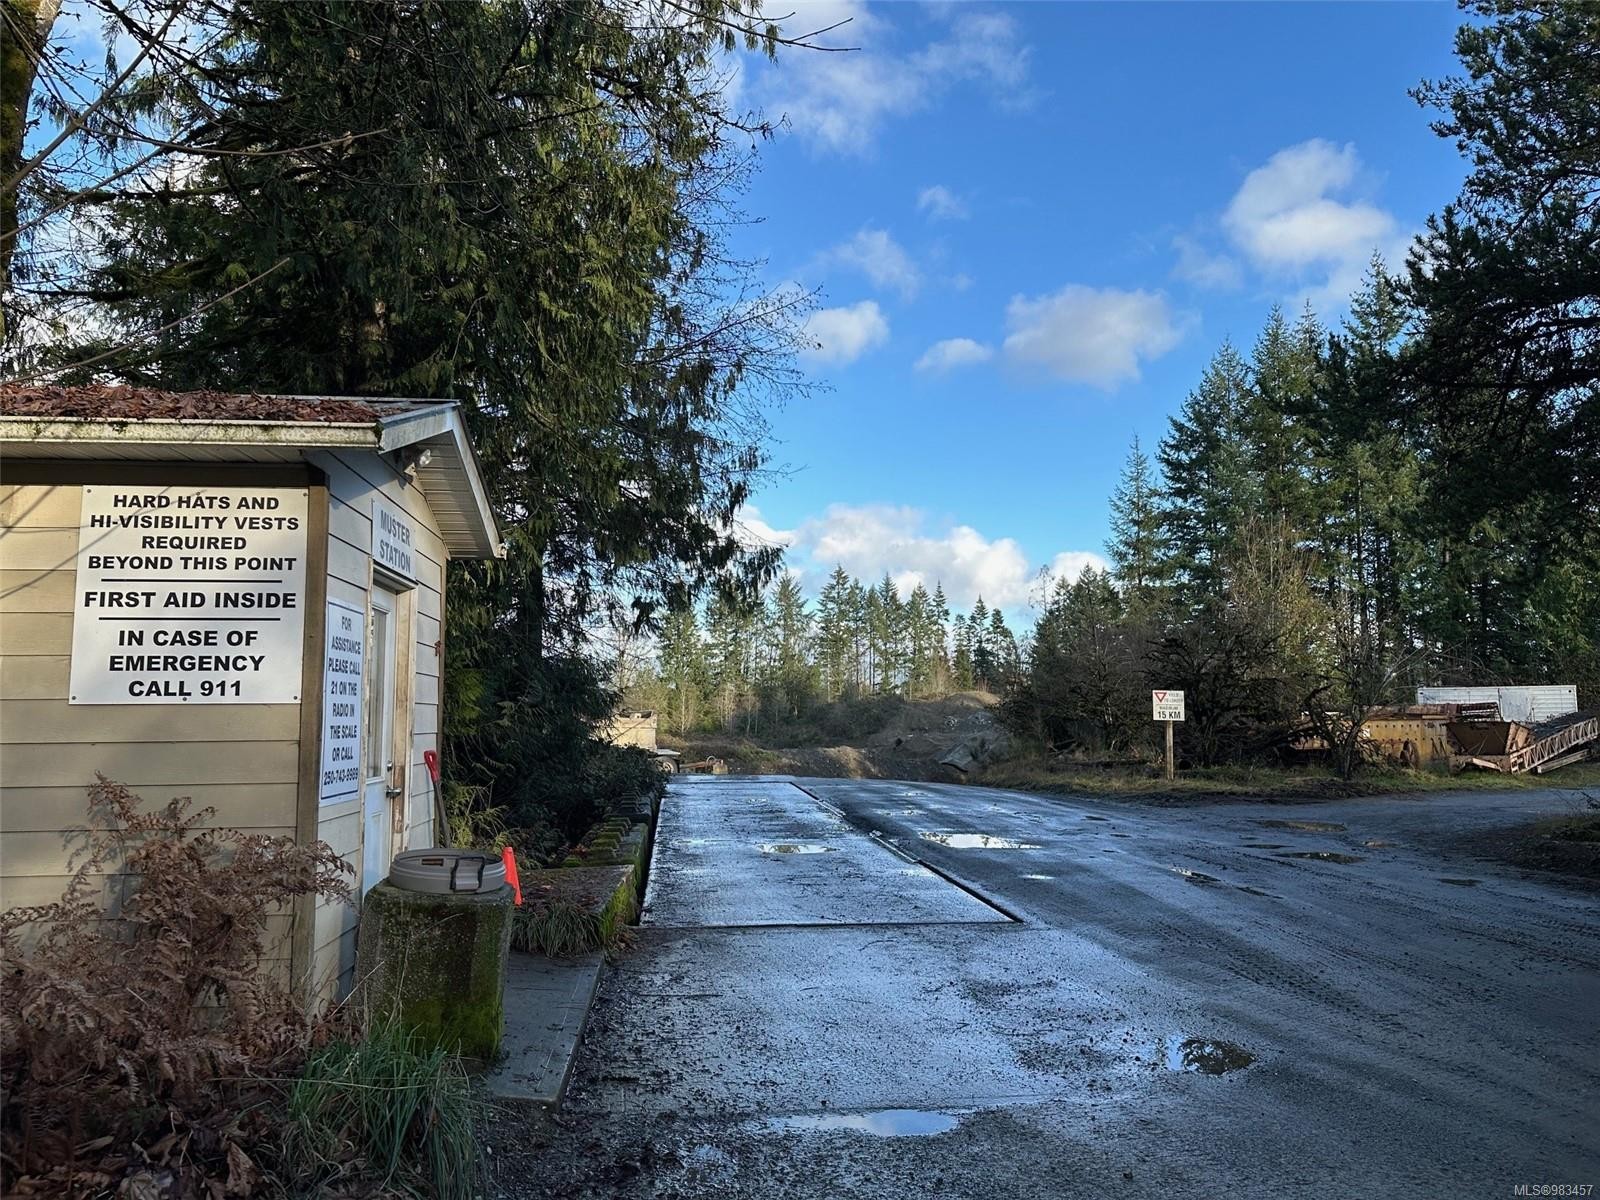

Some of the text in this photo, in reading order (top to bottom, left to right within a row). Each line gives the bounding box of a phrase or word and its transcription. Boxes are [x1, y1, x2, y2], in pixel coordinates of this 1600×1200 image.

[113, 494, 279, 510] HARD HATS AND
[90, 514, 299, 530] HI-VISIBILITY VESTS
[381, 510, 410, 547] MUSTER
[142, 536, 247, 550] REQUIRED
[88, 556, 297, 571] BEYOND THIS POINT
[380, 539, 410, 574] STATION
[84, 592, 297, 608] FIRST AID INSIDE
[341, 616, 352, 631] FOR
[118, 630, 258, 646] IN CASE OF
[331, 636, 361, 655] ASSISTANCE
[109, 656, 265, 672] EMERGENCY
[328, 658, 360, 675] PLEASE CALL
[128, 680, 241, 697] CALL 911
[331, 681, 357, 696] 21 ON THE
[332, 703, 355, 718] RADIO IN
[1158, 711, 1181, 719] 15 KM
[330, 725, 357, 740] THE SCALE
[332, 746, 353, 762] OR CALL
